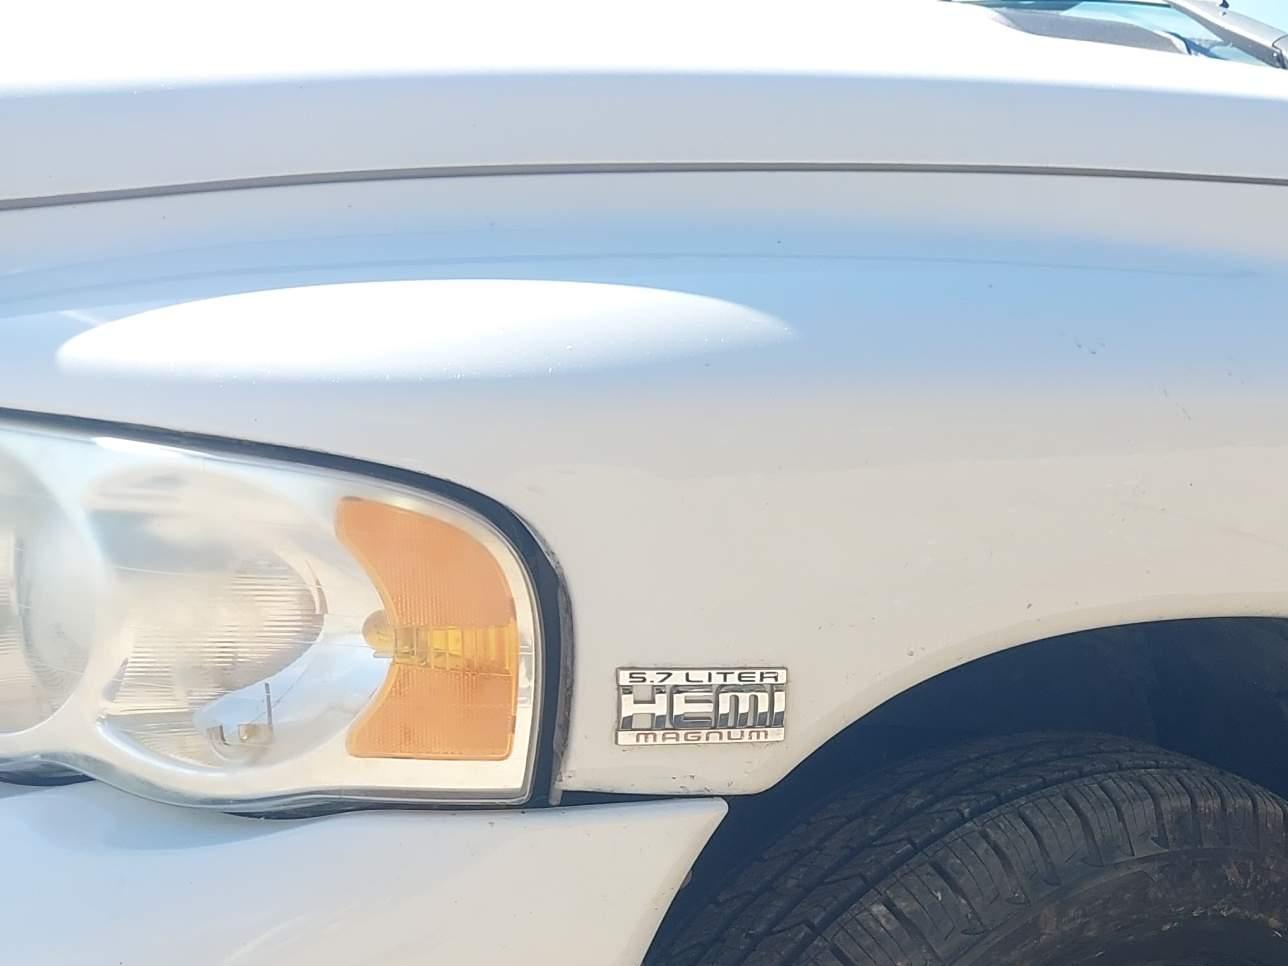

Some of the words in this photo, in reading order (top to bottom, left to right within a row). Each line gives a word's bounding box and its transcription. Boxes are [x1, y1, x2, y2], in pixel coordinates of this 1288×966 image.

[628, 671, 672, 683] 5.7
[685, 671, 779, 683] LITER
[620, 684, 786, 730] HEMI
[635, 730, 769, 743] MAGNUM
